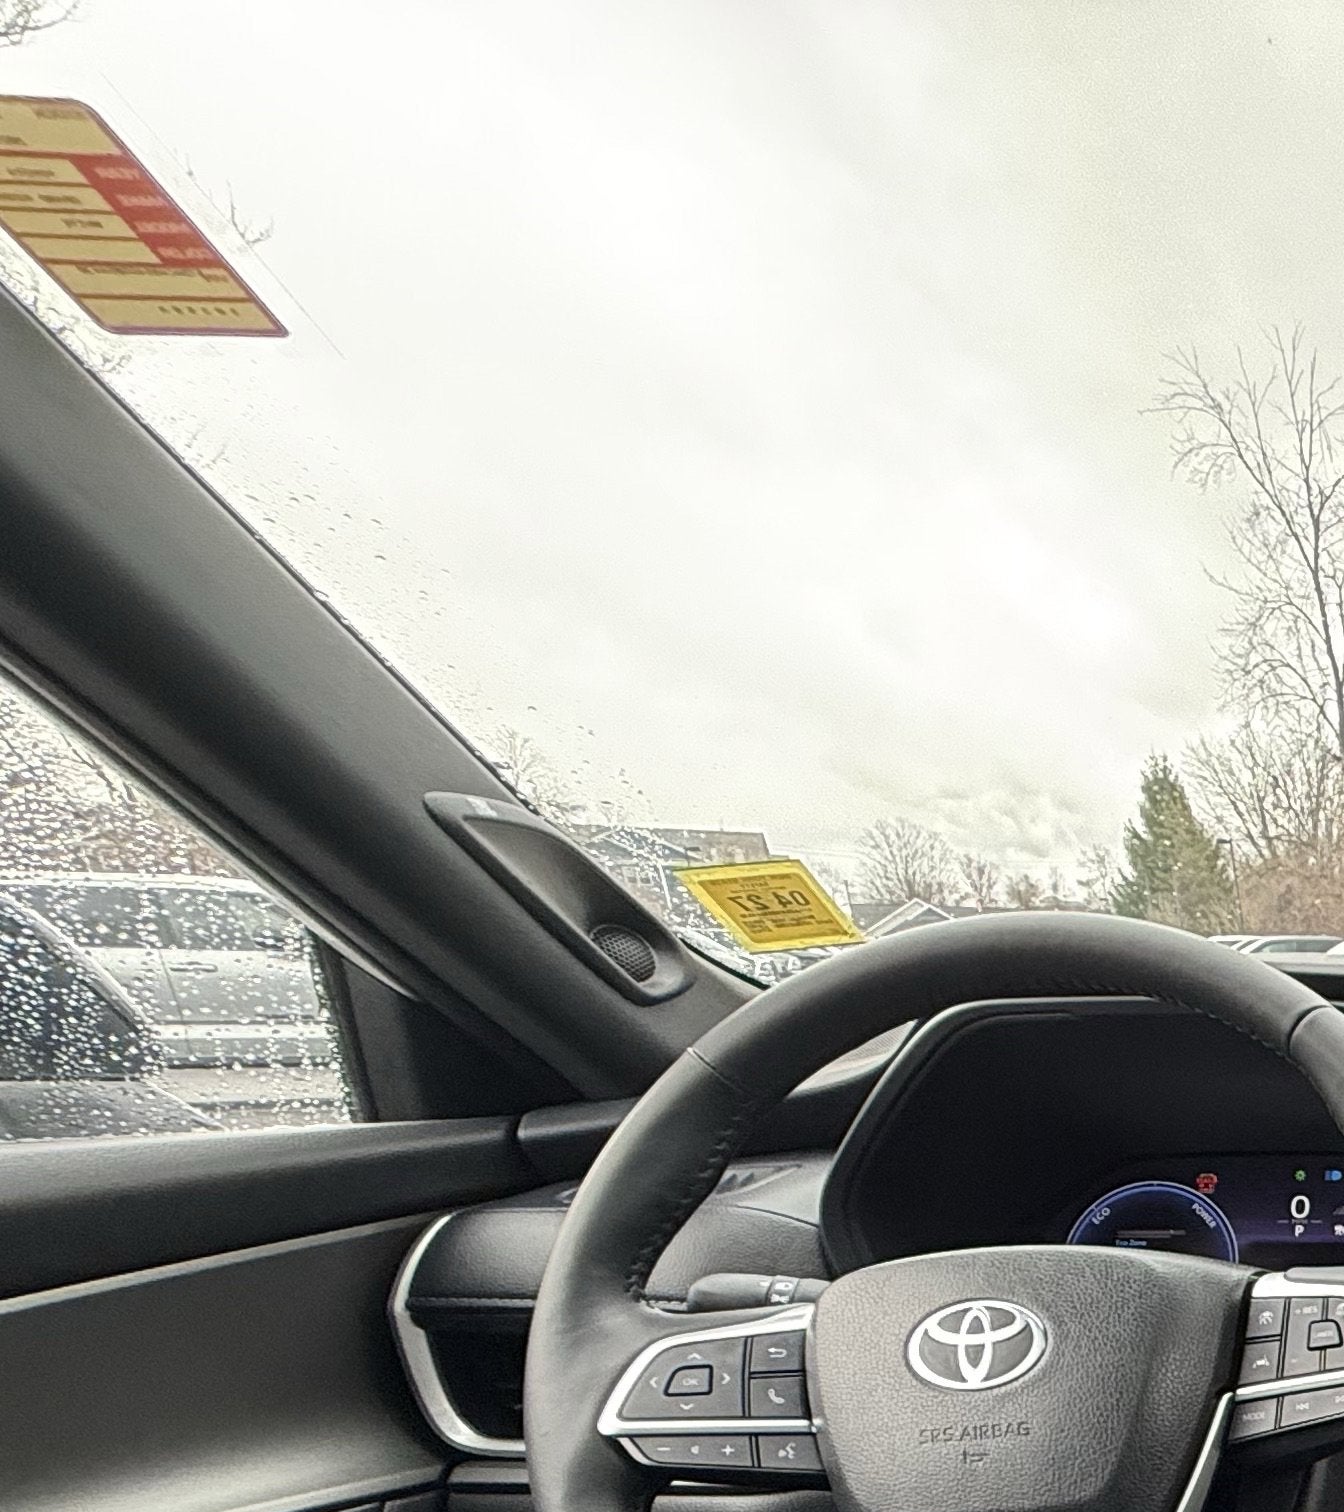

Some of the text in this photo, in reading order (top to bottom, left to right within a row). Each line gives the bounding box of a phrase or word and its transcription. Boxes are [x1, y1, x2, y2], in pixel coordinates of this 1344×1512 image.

[1091, 1206, 1112, 1226] ECO
[1191, 1202, 1218, 1230] POWER
[1290, 1195, 1311, 1219] 0
[1294, 1224, 1305, 1238] P
[919, 1420, 1032, 1445] SRS AIRBAG
